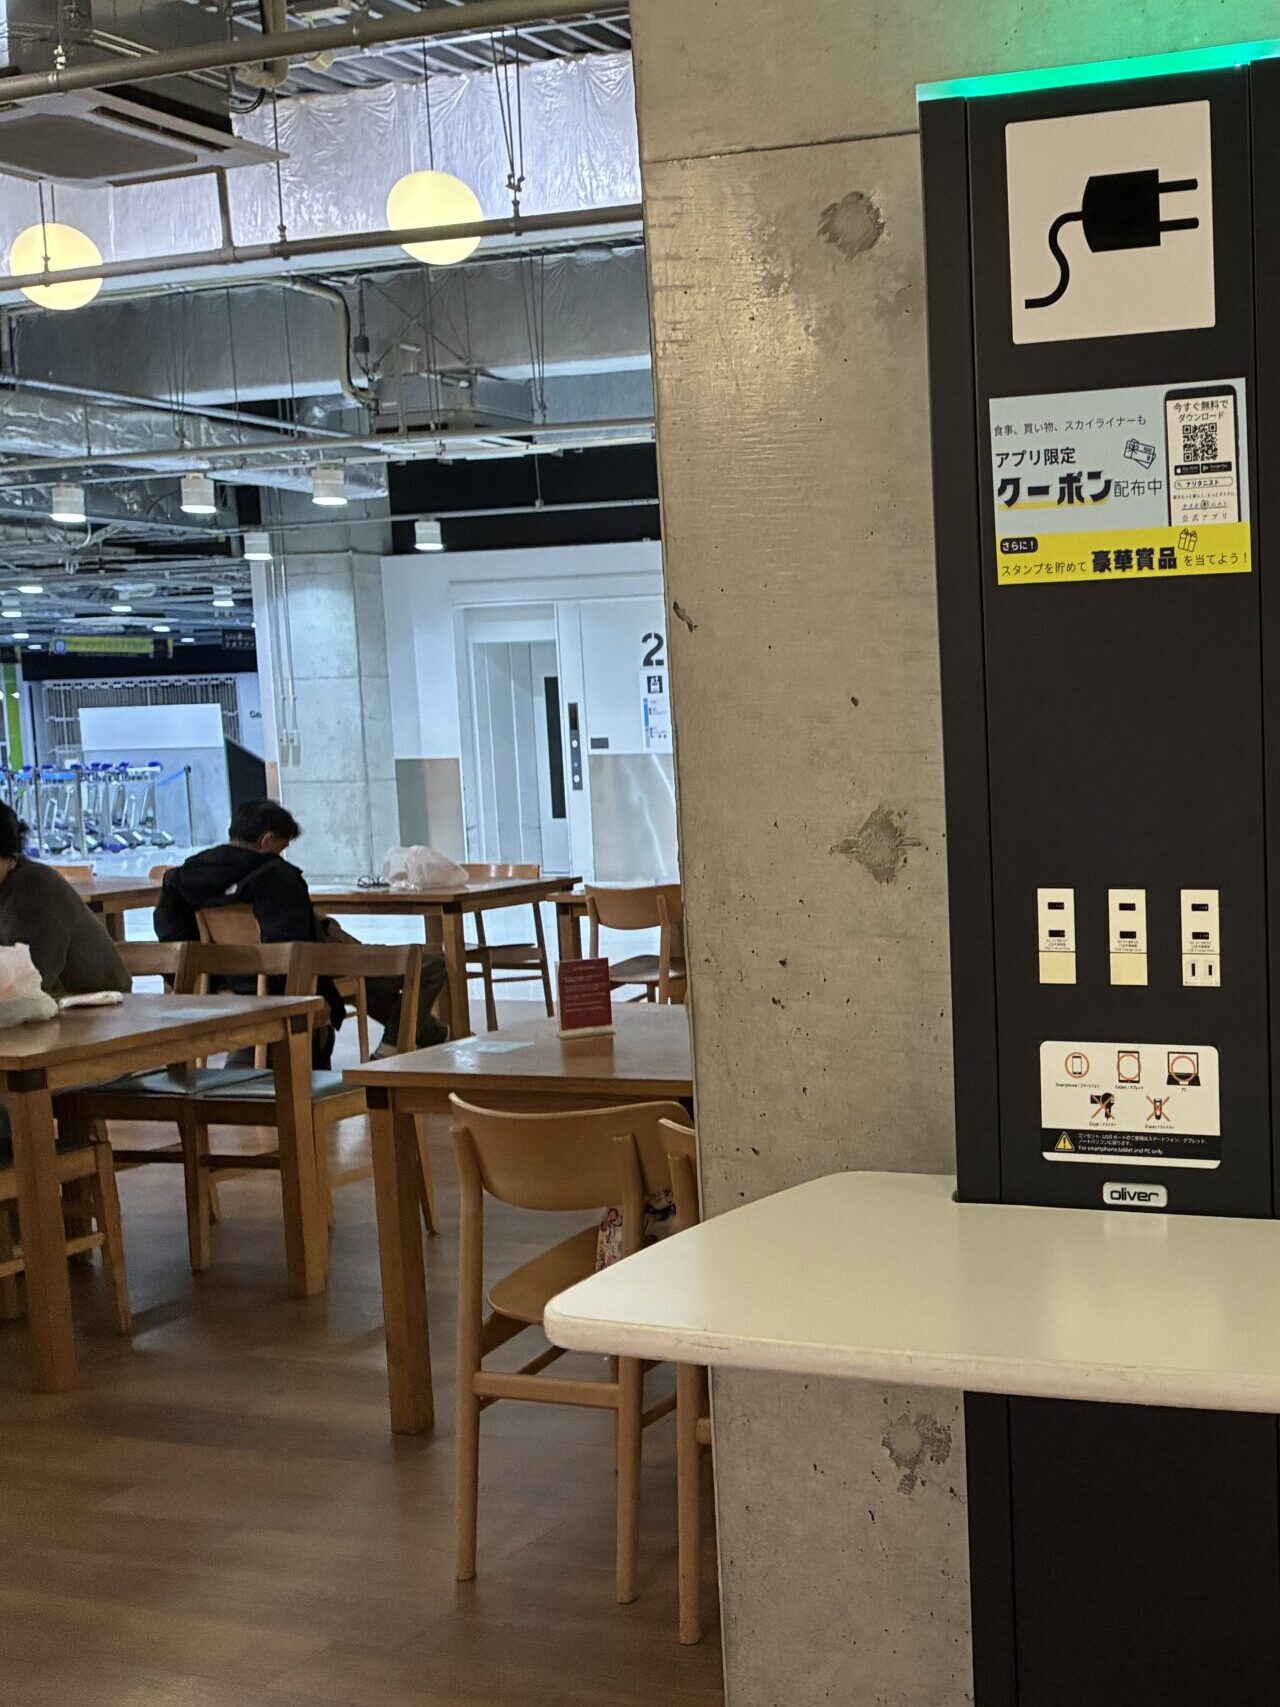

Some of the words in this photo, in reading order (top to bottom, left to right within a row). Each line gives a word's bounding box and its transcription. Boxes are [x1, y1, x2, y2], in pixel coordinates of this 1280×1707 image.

[1173, 400, 1229, 412] 今すぐ無料で
[994, 415, 1147, 437] 食事、買い物、スカイライナーも
[1178, 411, 1225, 423] ダウンロード
[995, 447, 1076, 468] アプリ限定
[641, 632, 665, 667] 2
[1110, 1187, 1159, 1202] oliver
